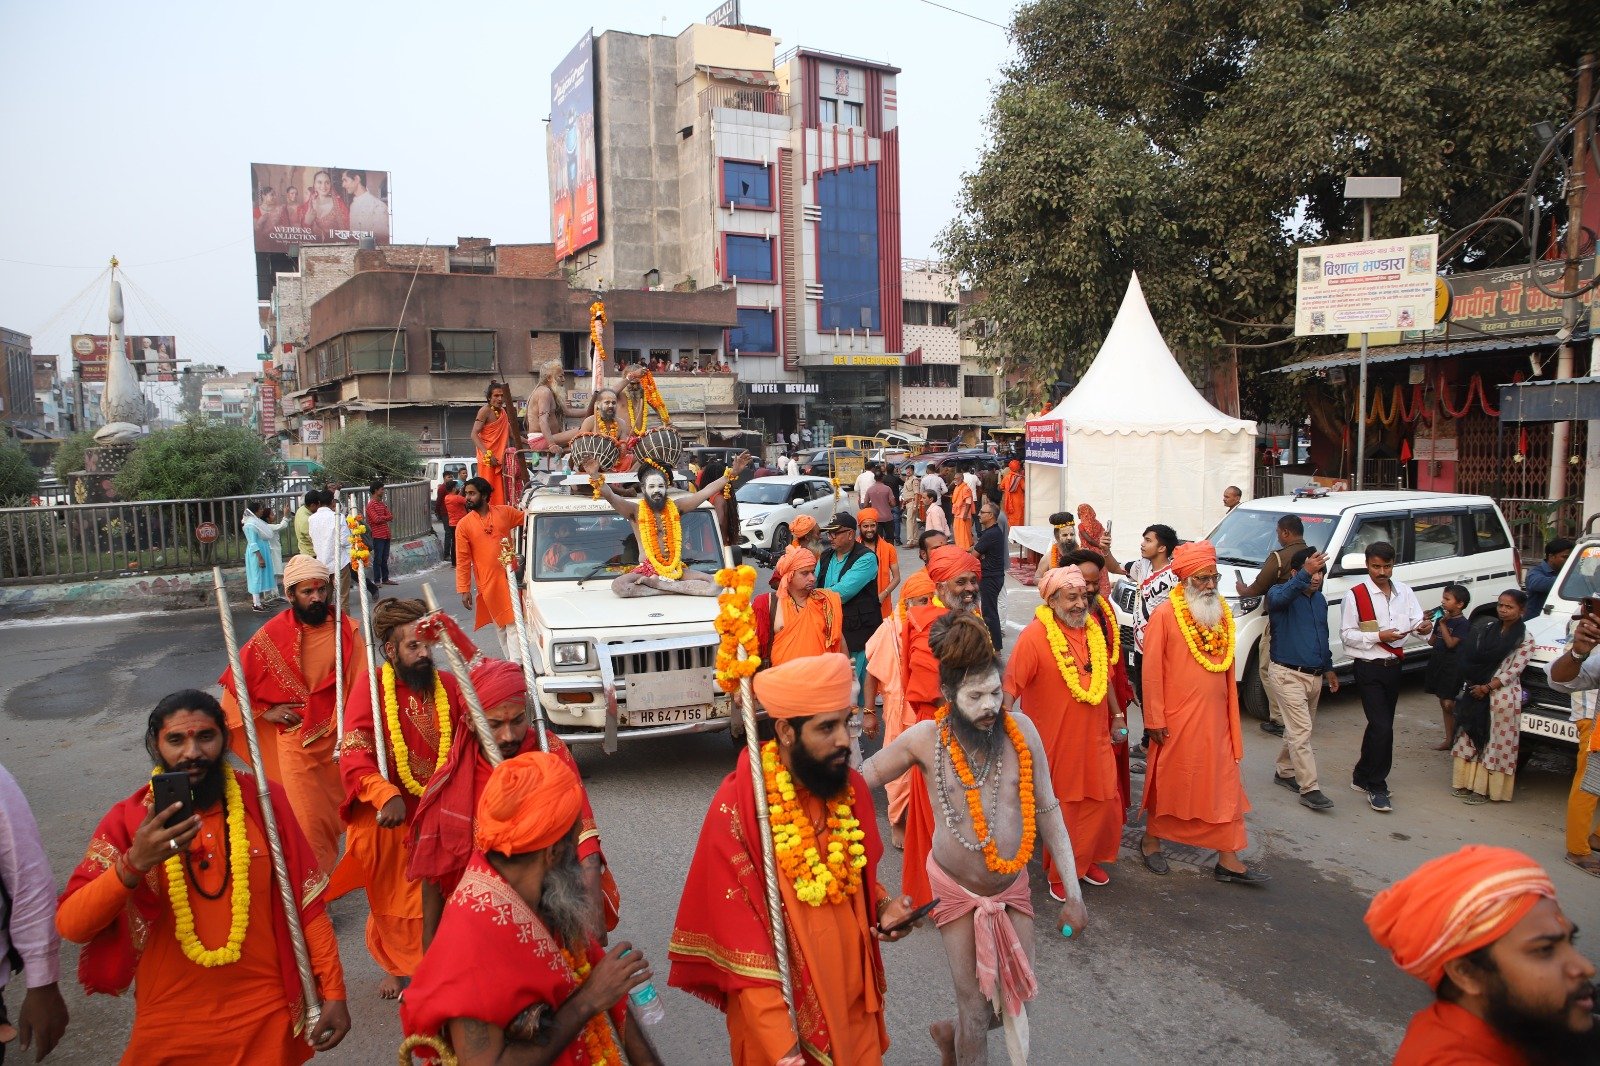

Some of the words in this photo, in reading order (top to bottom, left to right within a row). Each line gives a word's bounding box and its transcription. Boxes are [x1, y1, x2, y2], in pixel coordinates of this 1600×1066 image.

[706, 1, 733, 26] DEVLALI
[273, 226, 312, 234] WEDDING
[269, 232, 317, 240] COLLECTION
[1324, 261, 1358, 277] विशाल
[1363, 257, 1406, 272] भण्डारा
[1451, 286, 1499, 322] प्राचीन
[1501, 281, 1524, 315] माँ
[1540, 316, 1563, 326] प्रया
[833, 355, 849, 365] DEV
[852, 355, 900, 365] ENTERPRISES
[751, 384, 779, 394] HOTEL
[785, 384, 819, 394] DEVLALI
[641, 711, 654, 723] HR
[658, 711, 671, 722] 64
[674, 708, 701, 721] 7156
